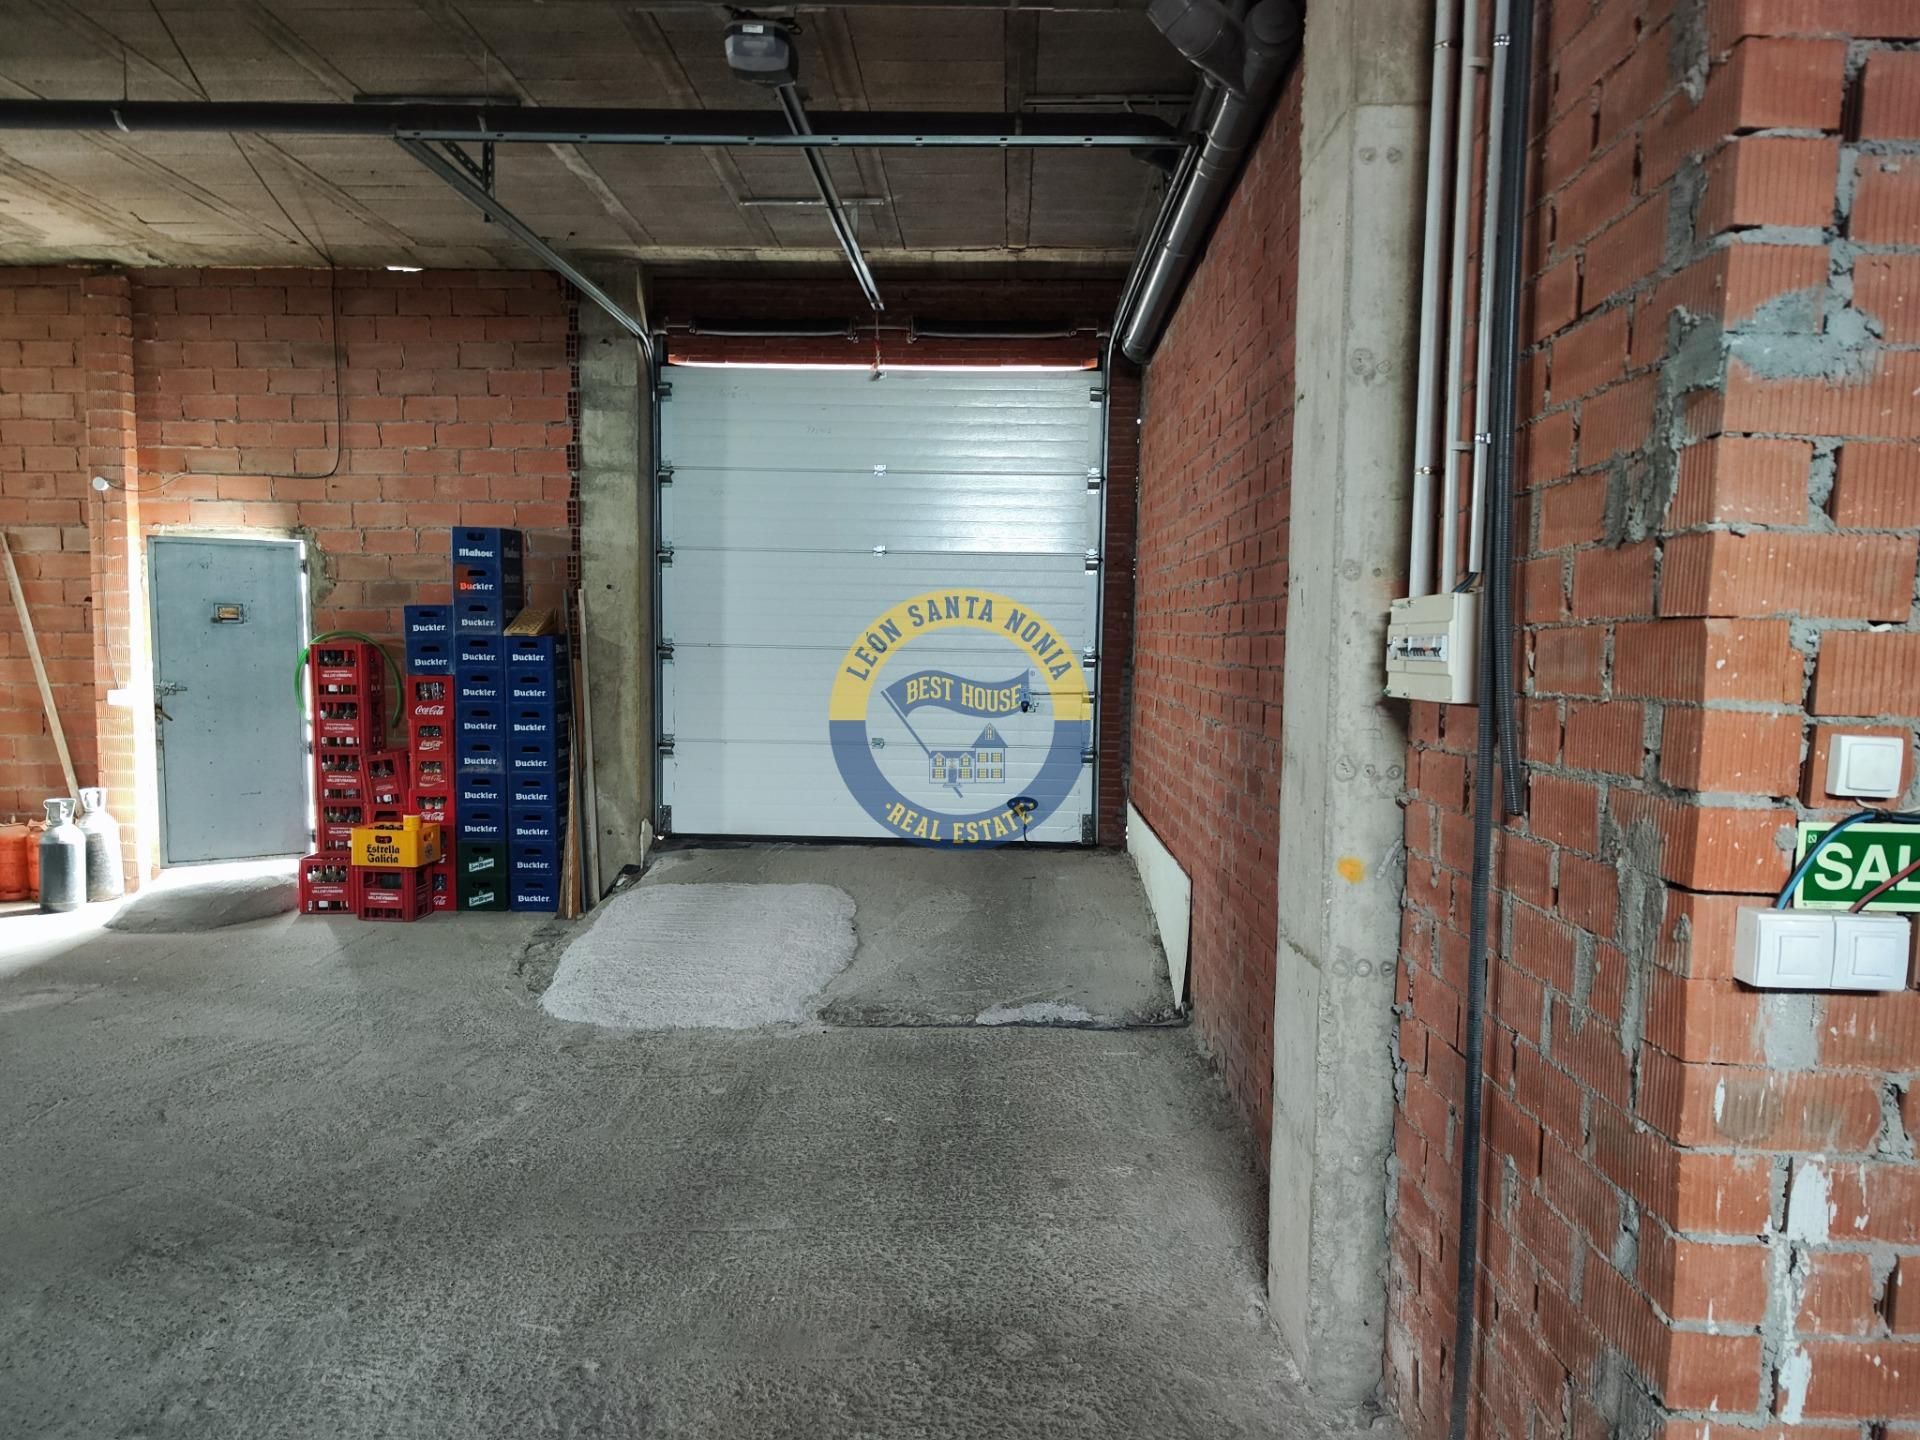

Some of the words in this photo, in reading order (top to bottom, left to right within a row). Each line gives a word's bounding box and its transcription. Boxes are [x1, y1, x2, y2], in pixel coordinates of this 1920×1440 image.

[459, 548, 493, 558] Mahou
[366, 844, 400, 854] Estrella
[367, 854, 399, 864] Galicia
